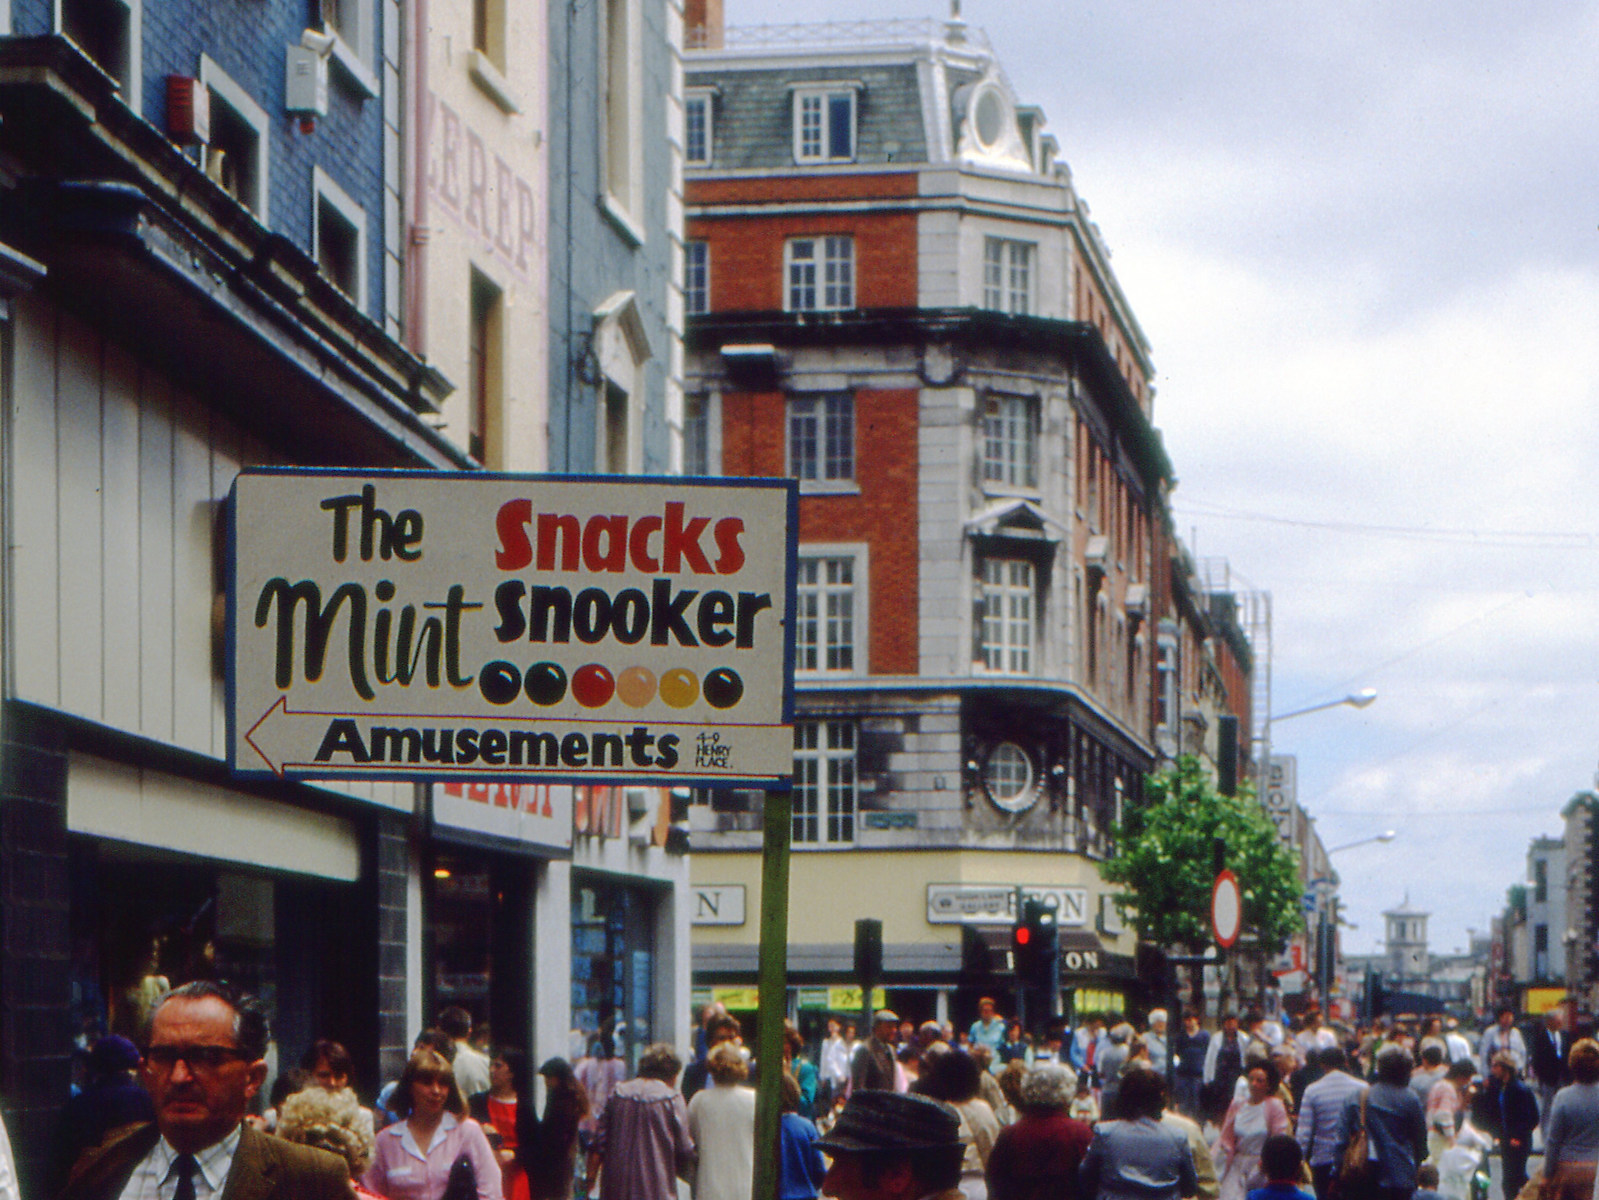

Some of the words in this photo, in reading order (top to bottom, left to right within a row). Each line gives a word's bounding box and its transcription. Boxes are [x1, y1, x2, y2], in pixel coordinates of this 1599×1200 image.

[320, 483, 424, 563] The
[495, 498, 745, 575] Snacks
[255, 577, 483, 701] Mint
[493, 578, 772, 649] Snooker
[313, 718, 681, 769] Amusements
[697, 744, 733, 757] HENRY
